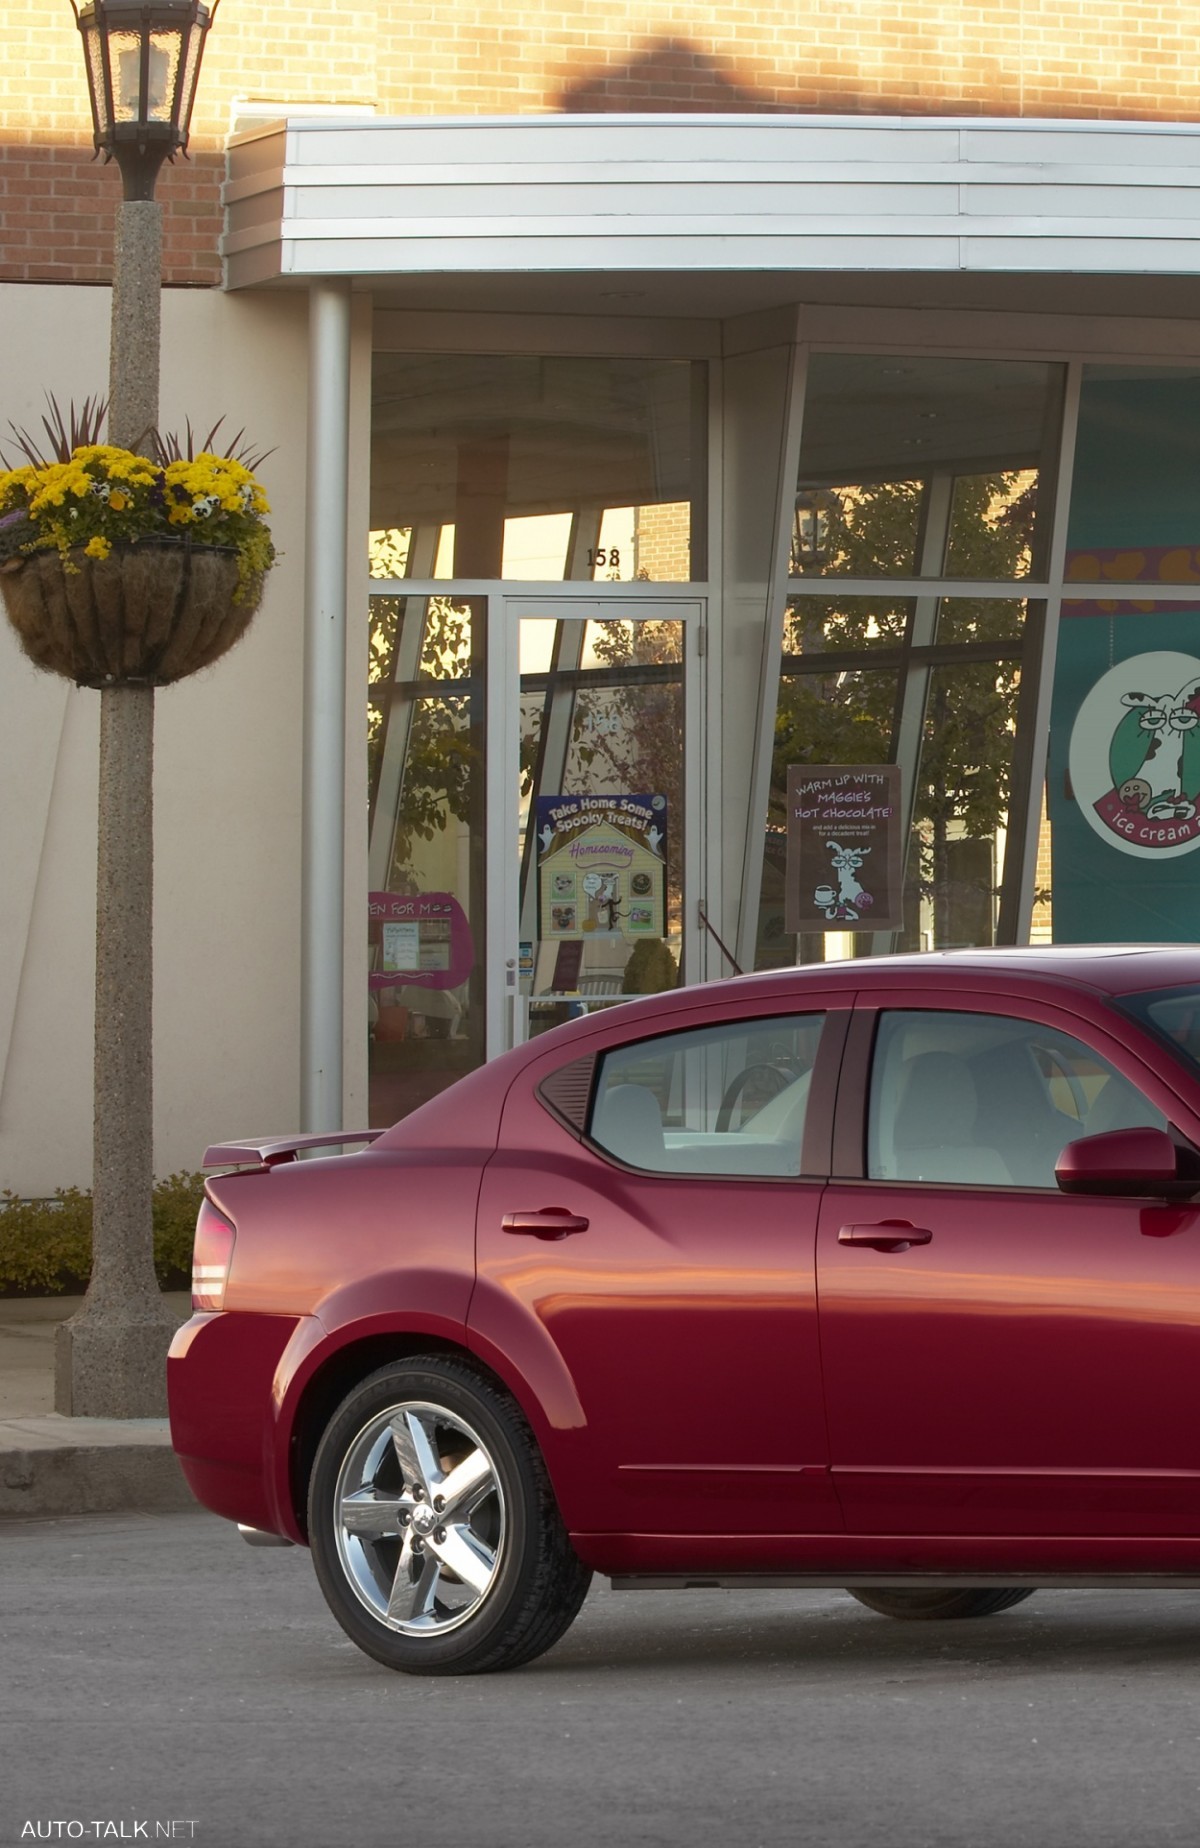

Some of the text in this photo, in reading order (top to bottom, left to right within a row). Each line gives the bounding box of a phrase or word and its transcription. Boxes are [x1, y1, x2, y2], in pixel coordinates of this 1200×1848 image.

[586, 548, 620, 567] 158
[796, 773, 884, 796] WARM UP WITH
[817, 790, 872, 804] MAGGIE'S
[548, 798, 654, 821] Take Home Some
[794, 808, 820, 818] HOT
[556, 811, 649, 832] Spooky Treats!
[1112, 809, 1135, 834] ice
[1140, 825, 1191, 841] cream
[568, 842, 635, 862] Homecoming
[391, 902, 414, 915] FOR
